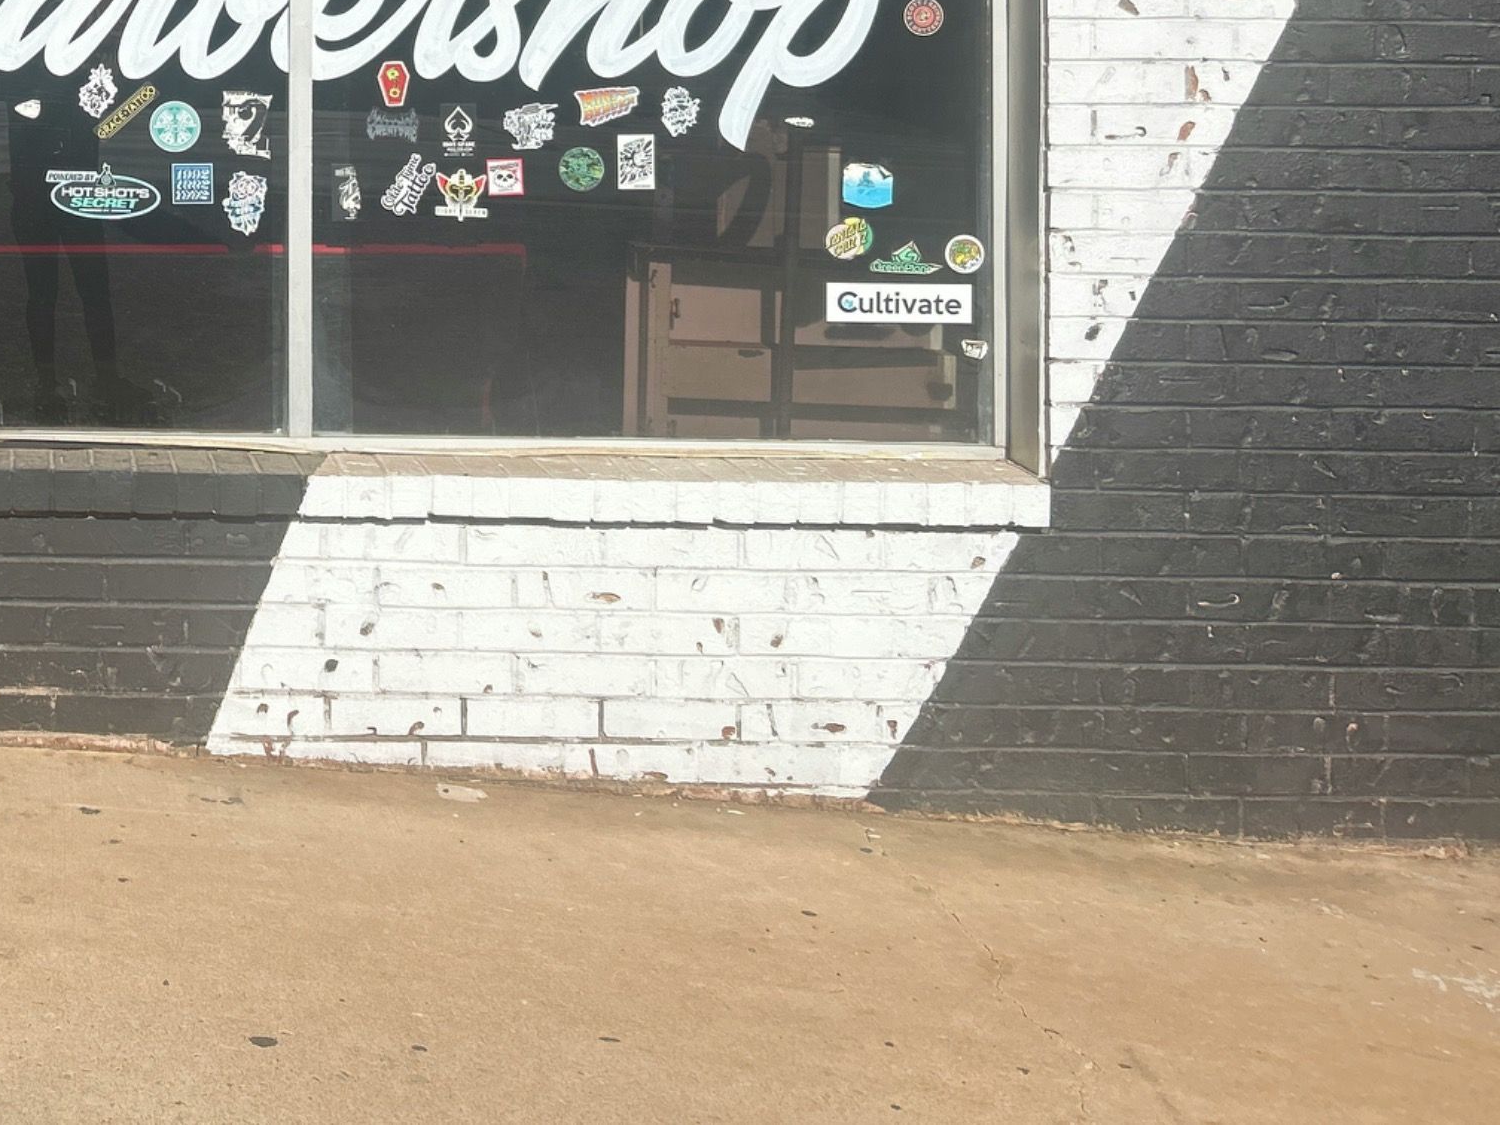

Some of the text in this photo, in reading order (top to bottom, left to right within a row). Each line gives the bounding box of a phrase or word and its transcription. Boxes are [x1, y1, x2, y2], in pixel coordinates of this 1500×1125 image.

[61, 187, 150, 199] HOT SHOT'S
[394, 163, 436, 214] Tattoo
[69, 198, 139, 209] SECRET
[837, 290, 962, 316] Cultivate
